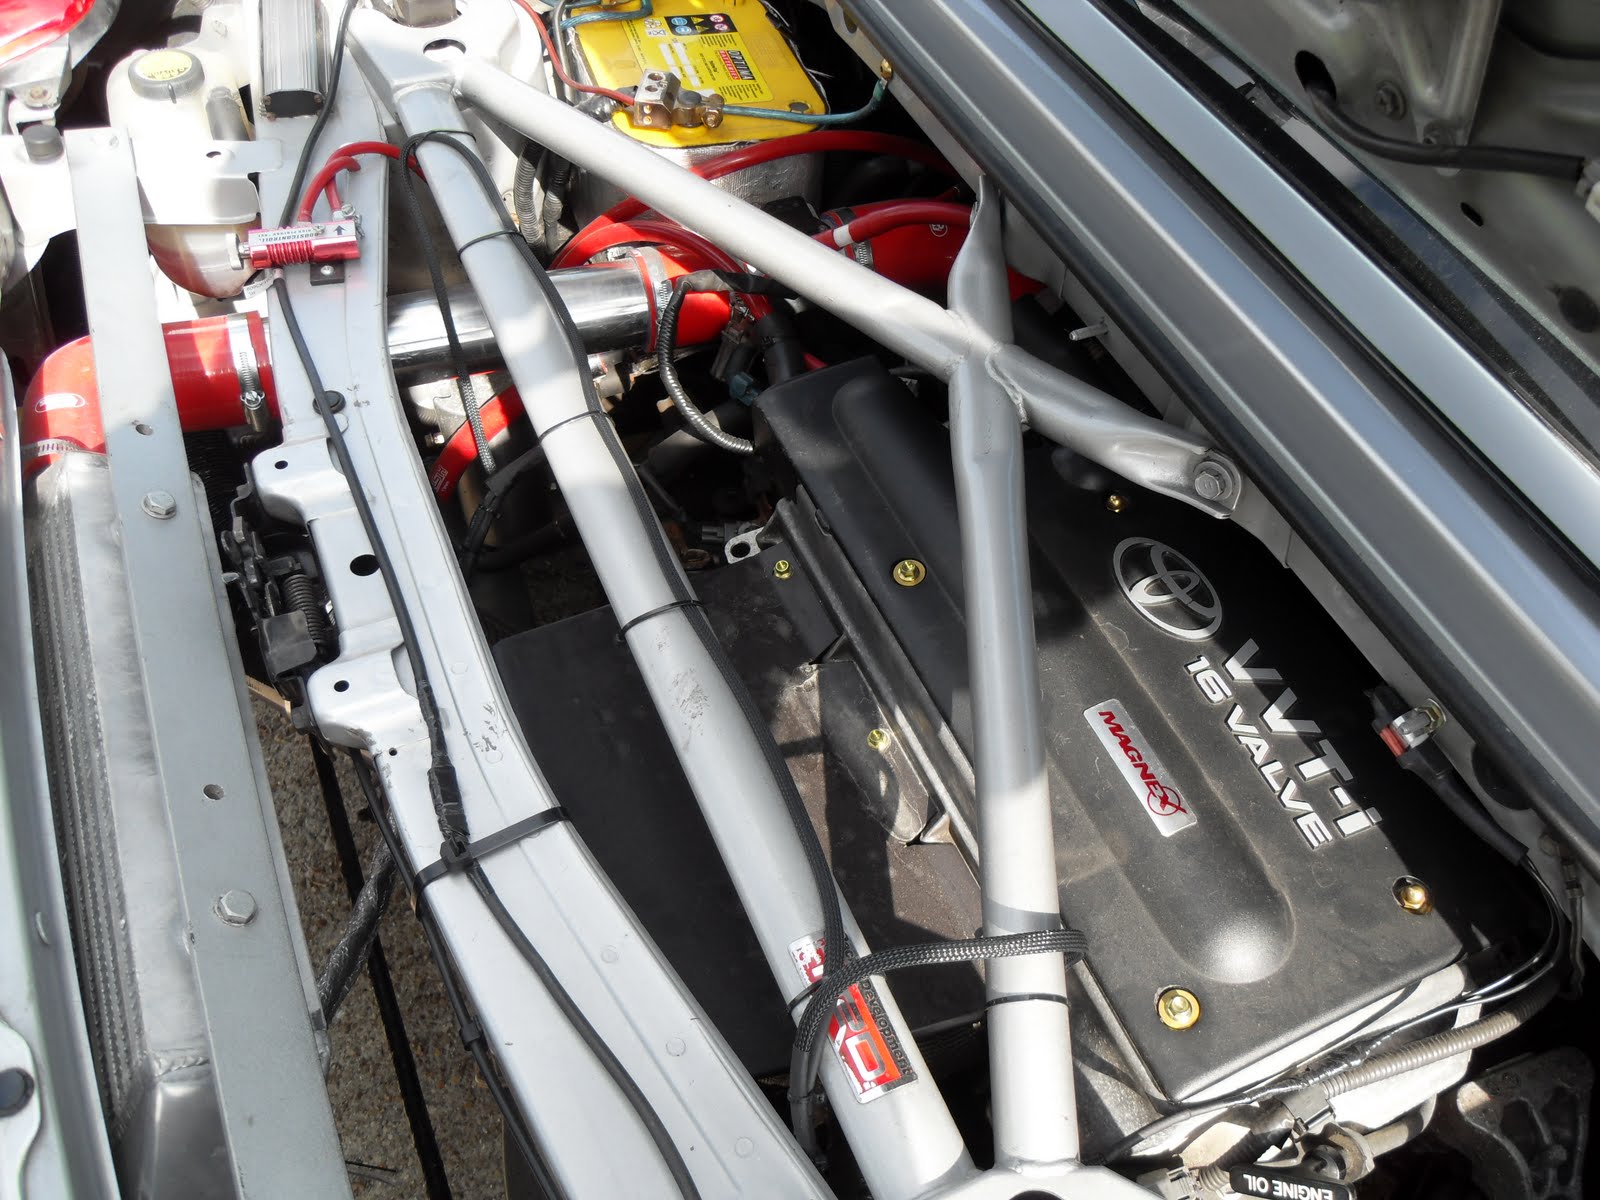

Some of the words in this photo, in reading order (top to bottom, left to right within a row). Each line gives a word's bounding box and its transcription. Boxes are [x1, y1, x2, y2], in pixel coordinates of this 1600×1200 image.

[1098, 710, 1187, 816] MAGNEX
[1184, 655, 1233, 703] 16
[1226, 703, 1333, 849] VALVE
[859, 979, 914, 1076] Development
[1243, 1174, 1269, 1193] OIL
[1272, 1180, 1333, 1200] ENGINE
